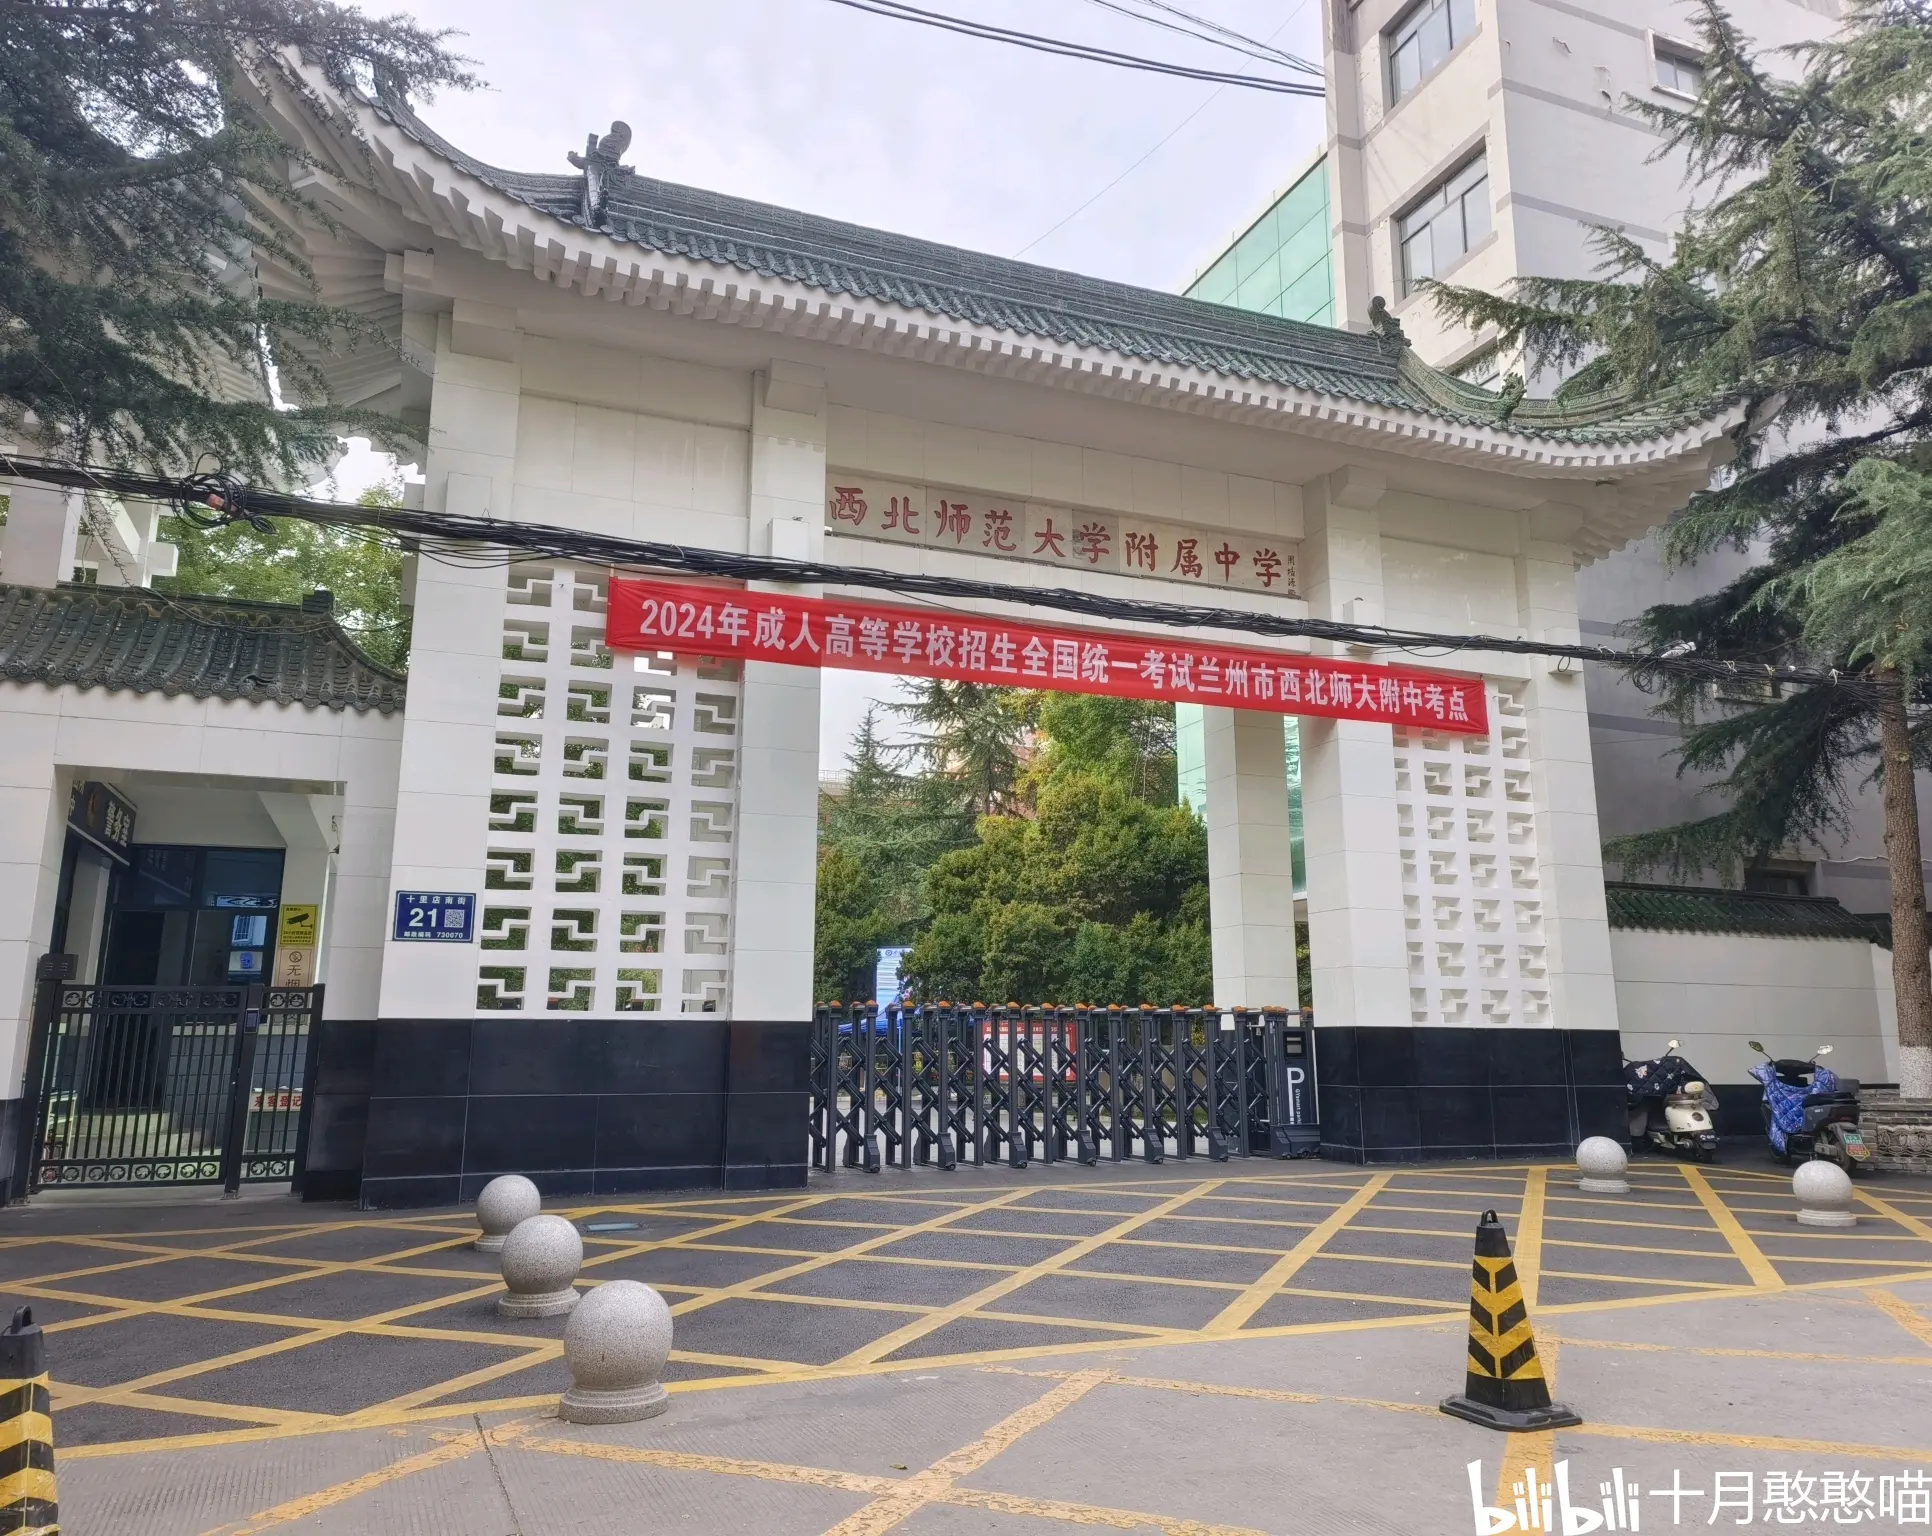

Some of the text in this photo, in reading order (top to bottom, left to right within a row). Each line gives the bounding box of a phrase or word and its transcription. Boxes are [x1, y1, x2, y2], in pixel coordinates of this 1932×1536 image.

[829, 486, 1283, 587] 西北师范大学附属中学
[640, 599, 1469, 723] 2024年成人高等学校招生全国统一考试兰州市西北师大附中考点
[406, 895, 466, 905] 十里店南街
[409, 908, 437, 927] 21
